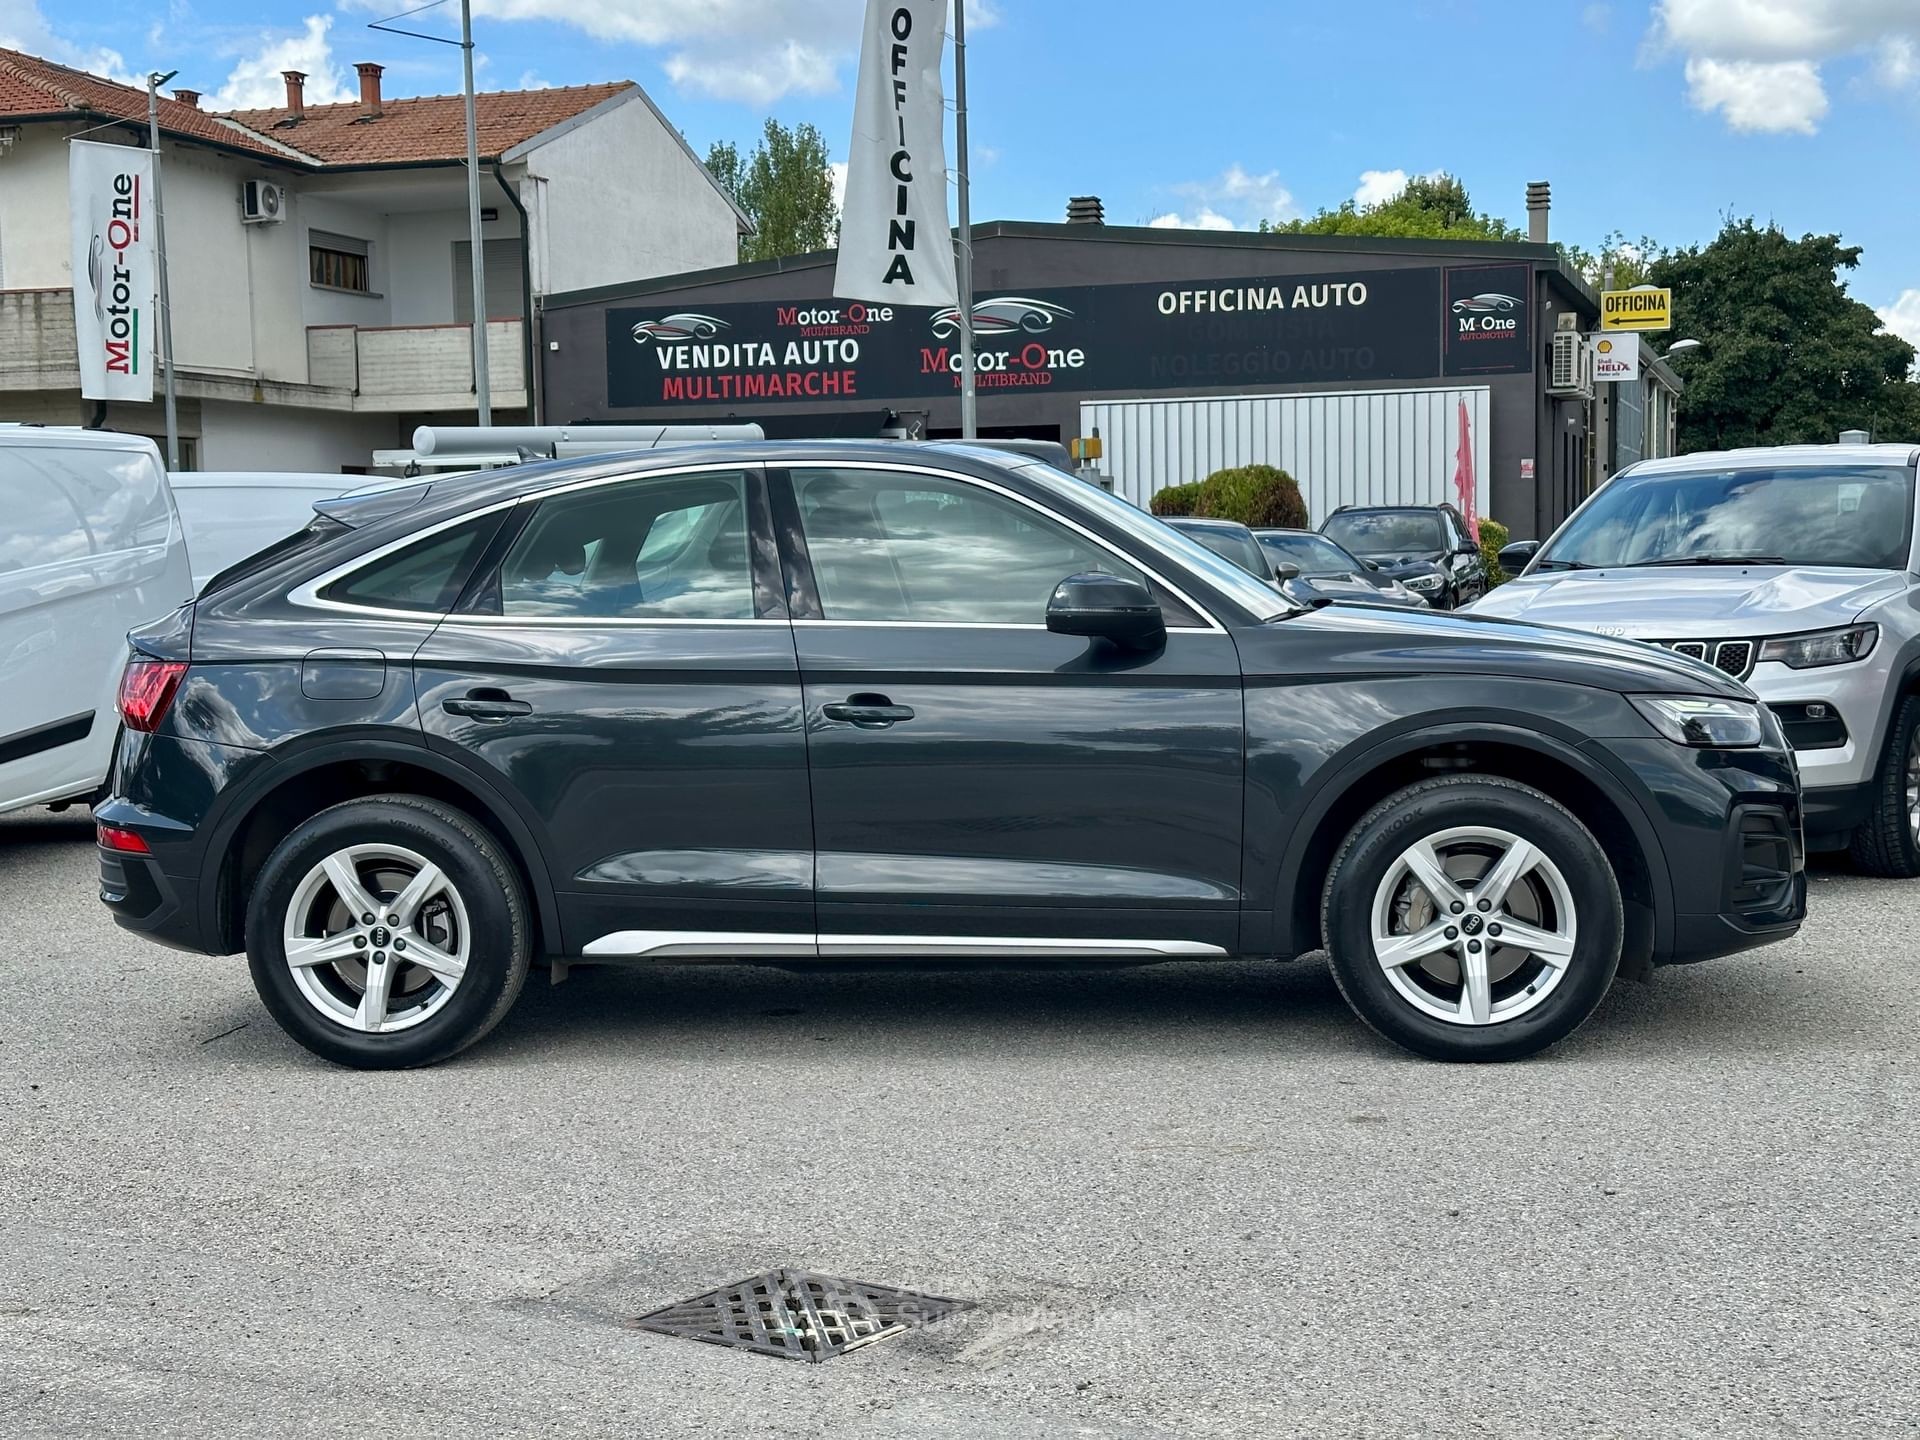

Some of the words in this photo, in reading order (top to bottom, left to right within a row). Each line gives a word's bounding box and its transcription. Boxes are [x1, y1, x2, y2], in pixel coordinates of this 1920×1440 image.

[882, 7, 915, 286] OFFICINA
[105, 173, 133, 375] Motor-One
[1157, 286, 1285, 315] OFFICINA
[1290, 282, 1368, 309] AUTO
[1605, 294, 1666, 313] OFFICINA
[776, 303, 894, 327] Motor-One
[1458, 316, 1517, 332] M-One
[800, 323, 870, 338] MULTIBRAND
[1459, 330, 1517, 341] AUTOMOTIVE
[655, 342, 777, 370] VENDITA
[783, 338, 860, 366] AUTO
[920, 343, 1086, 374] Moor-One
[1597, 361, 1632, 372] HELIX
[662, 370, 857, 400] MULTIMARCHE
[953, 371, 1052, 389] MLTIBRAND
